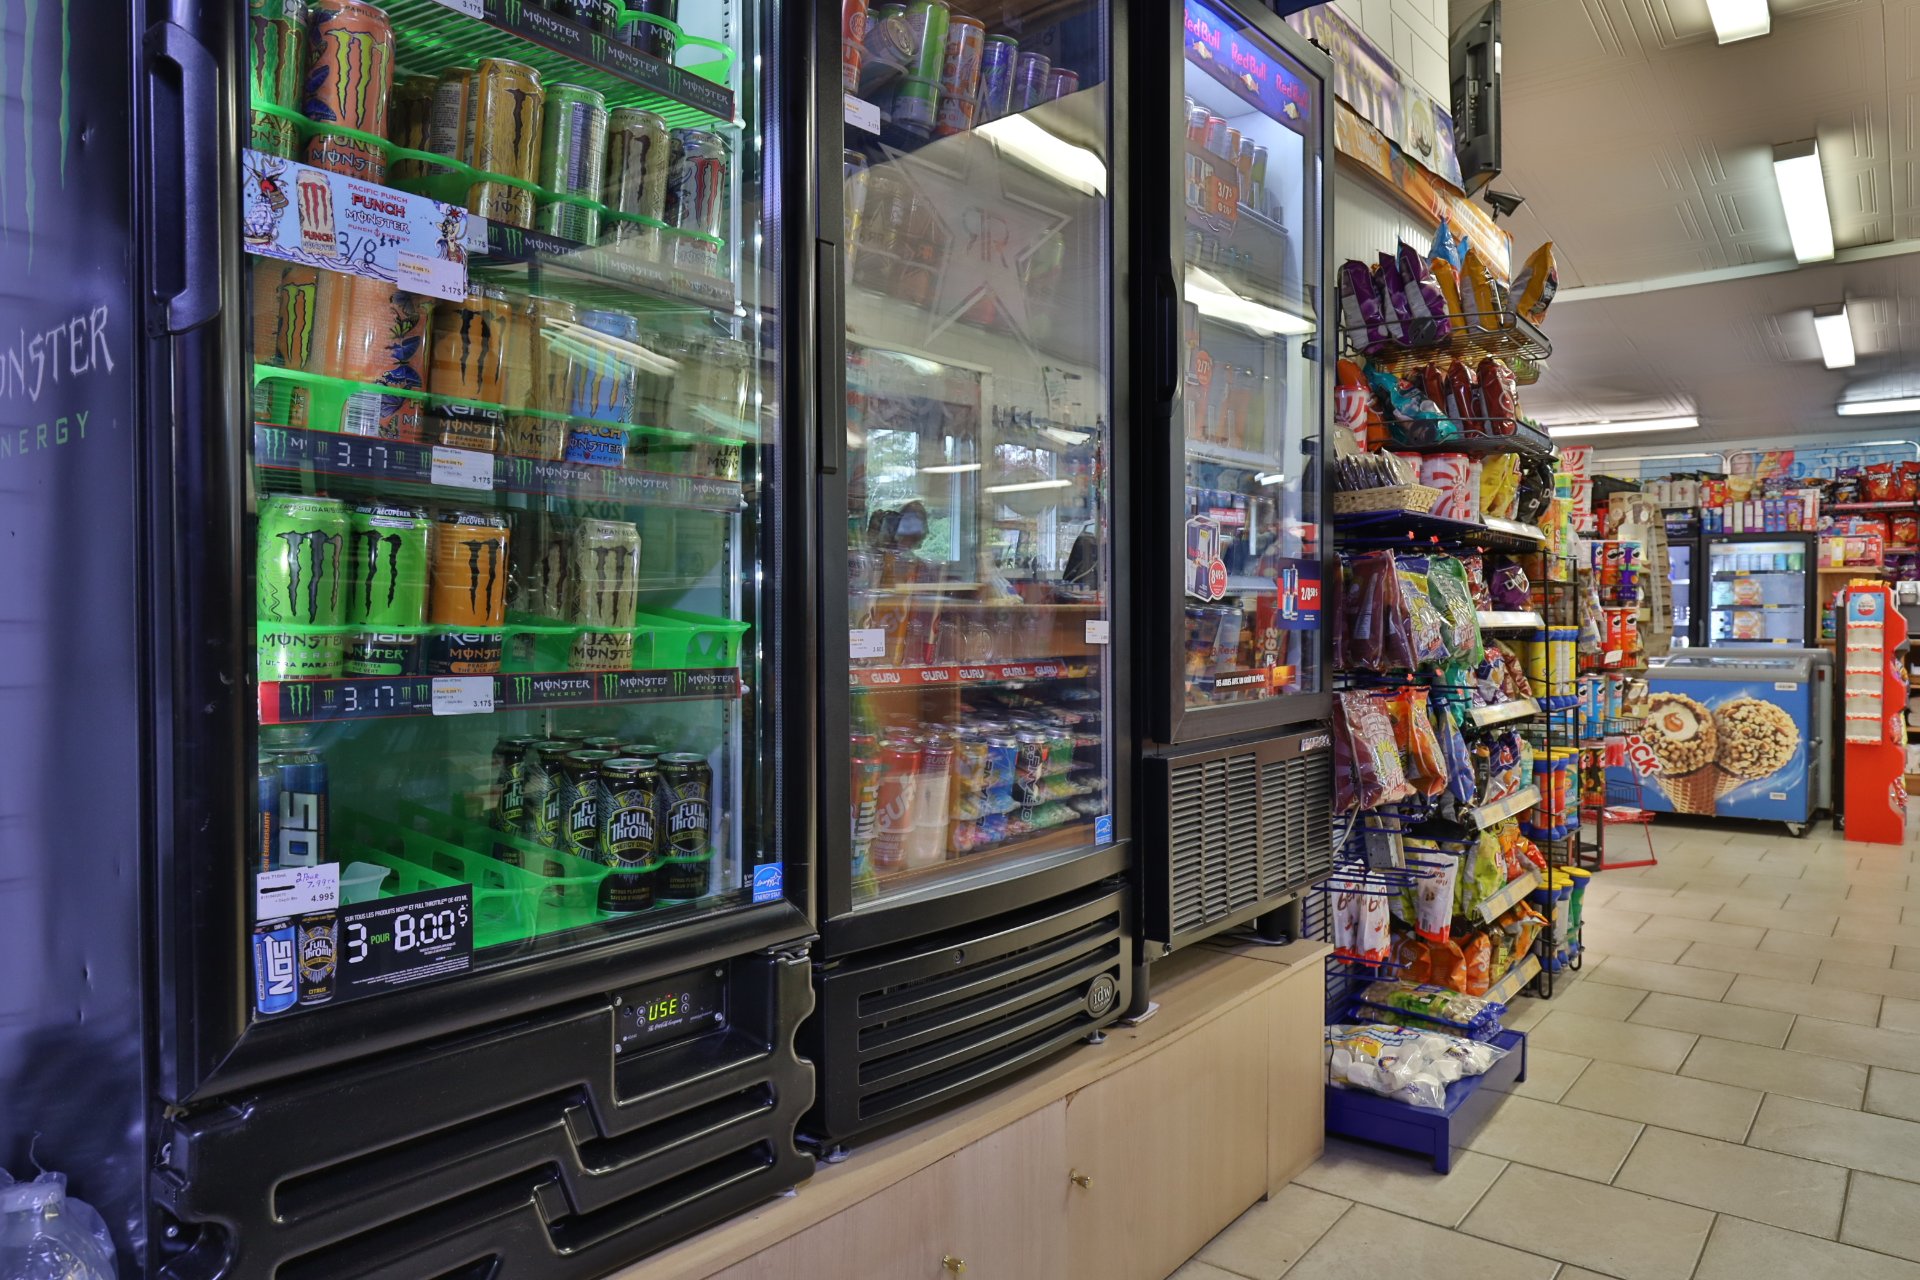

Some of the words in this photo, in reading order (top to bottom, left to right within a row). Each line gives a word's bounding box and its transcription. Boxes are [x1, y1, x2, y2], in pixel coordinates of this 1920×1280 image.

[522, 8, 581, 42] MONSTER
[608, 46, 659, 76] MONSTER
[682, 78, 729, 105] MONSTER
[348, 183, 379, 197] PACIFIC
[380, 190, 408, 204] PUNCH
[351, 193, 406, 218] PUNCH
[345, 209, 410, 234] MONSTER
[347, 223, 374, 234] PUNCH
[303, 230, 334, 242] PUNCH
[467, 237, 486, 248] 3.17$
[525, 237, 582, 260] MONSTER
[610, 259, 663, 280] MONSTER
[441, 284, 462, 296] 3.17$
[337, 441, 388, 469] 3.17
[472, 475, 491, 485] 3.17$
[535, 466, 592, 481] MONSTER
[618, 475, 670, 491] MONSTER
[692, 484, 739, 498] MONSTER
[871, 671, 900, 684] GURU
[921, 669, 949, 681] GURU
[959, 668, 985, 679] GURU
[1002, 665, 1026, 678] GURU
[533, 677, 591, 691] MONSTER
[688, 674, 735, 685] MONSTER
[344, 686, 394, 711] 3.17
[473, 699, 492, 708] 3.17$
[311, 894, 335, 903] 4.99$
[366, 911, 374, 919] LES
[374, 908, 396, 917] PRODUITS
[415, 902, 425, 910] FULL
[347, 922, 368, 964] 3
[370, 932, 390, 945] POUR
[269, 940, 293, 996] NOS
[649, 998, 677, 1021] USE
